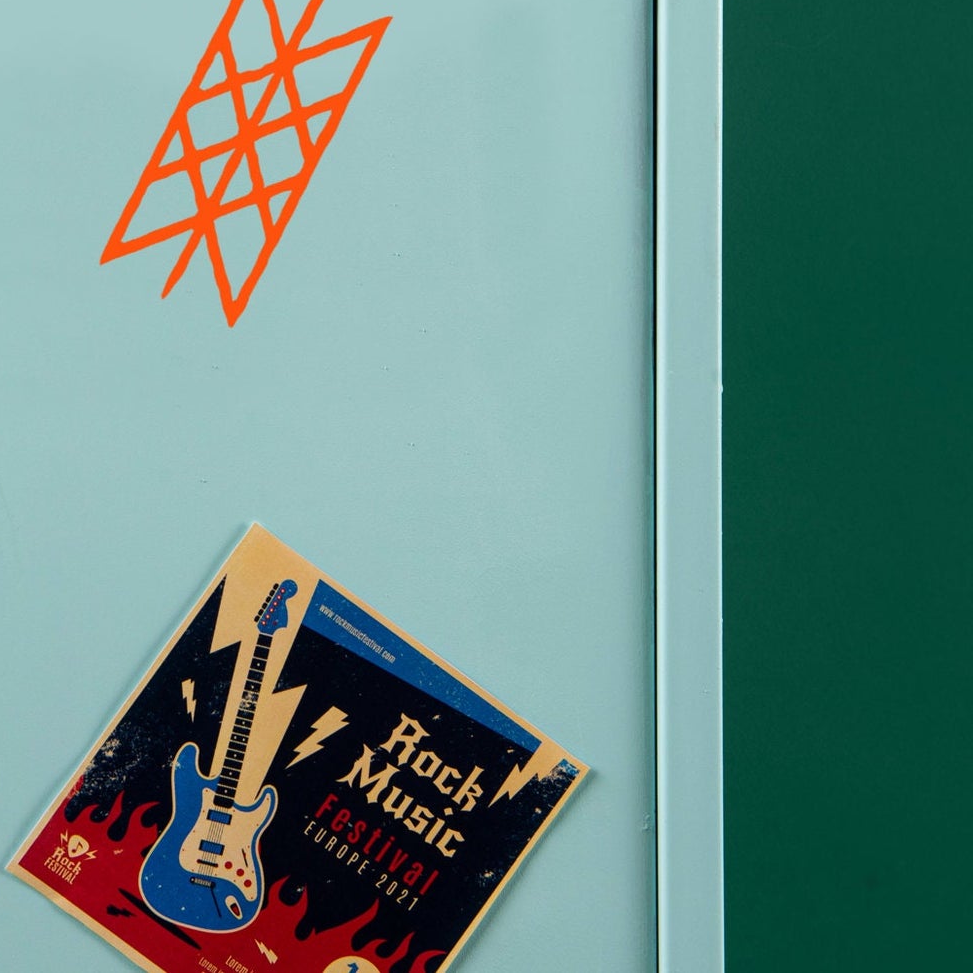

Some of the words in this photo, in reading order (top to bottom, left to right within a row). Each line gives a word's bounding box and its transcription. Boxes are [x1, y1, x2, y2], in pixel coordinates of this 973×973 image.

[335, 743, 465, 858] Music
[380, 712, 485, 812] Rock
[43, 856, 77, 885] FESTIVAL
[304, 820, 371, 876] EUROPE
[375, 873, 419, 911] 2021
[315, 793, 439, 896] Festival
